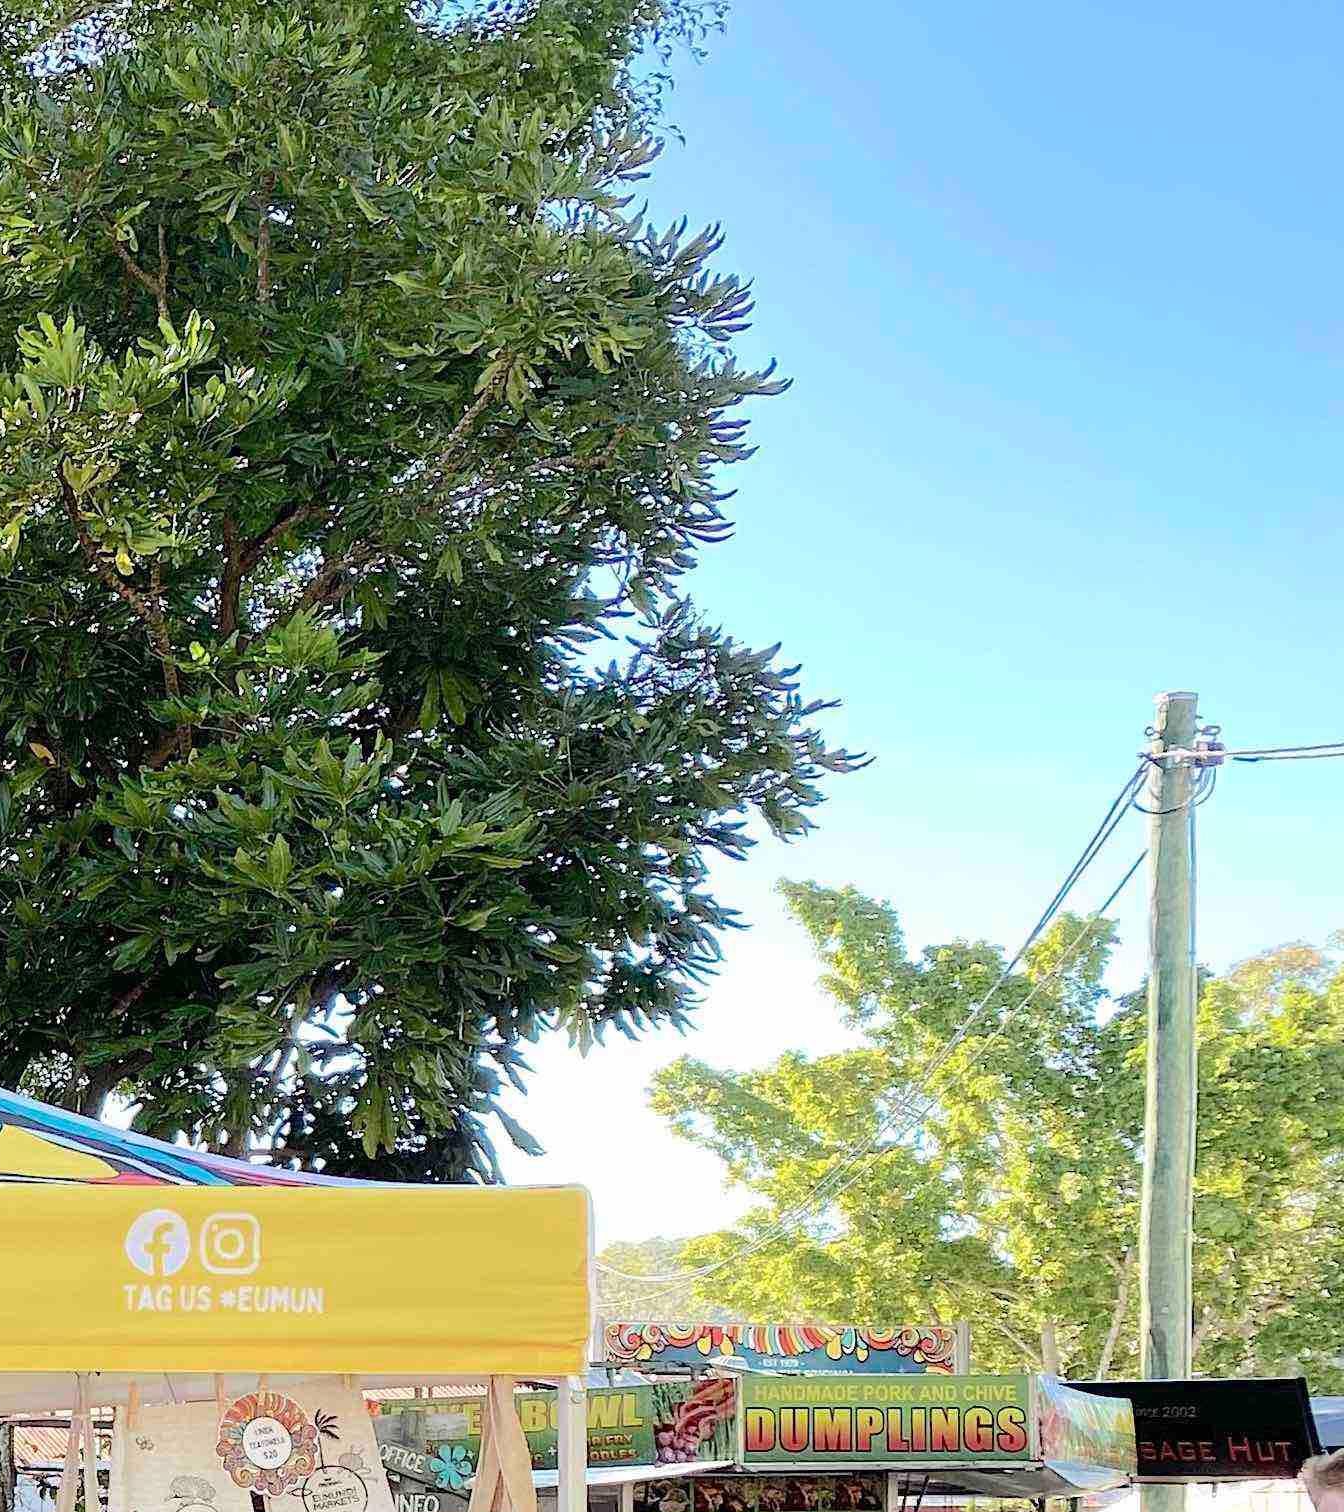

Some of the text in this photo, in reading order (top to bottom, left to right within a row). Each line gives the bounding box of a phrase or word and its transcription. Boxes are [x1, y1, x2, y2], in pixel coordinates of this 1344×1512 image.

[123, 1284, 174, 1313] TAG
[180, 1285, 212, 1313] US
[754, 1384, 1017, 1402] HANDMADE PORK AND CHIVE
[744, 1406, 1028, 1453] DUMPLINGS
[380, 1444, 427, 1474] OFFICE
[1139, 1440, 1217, 1462] SAGE
